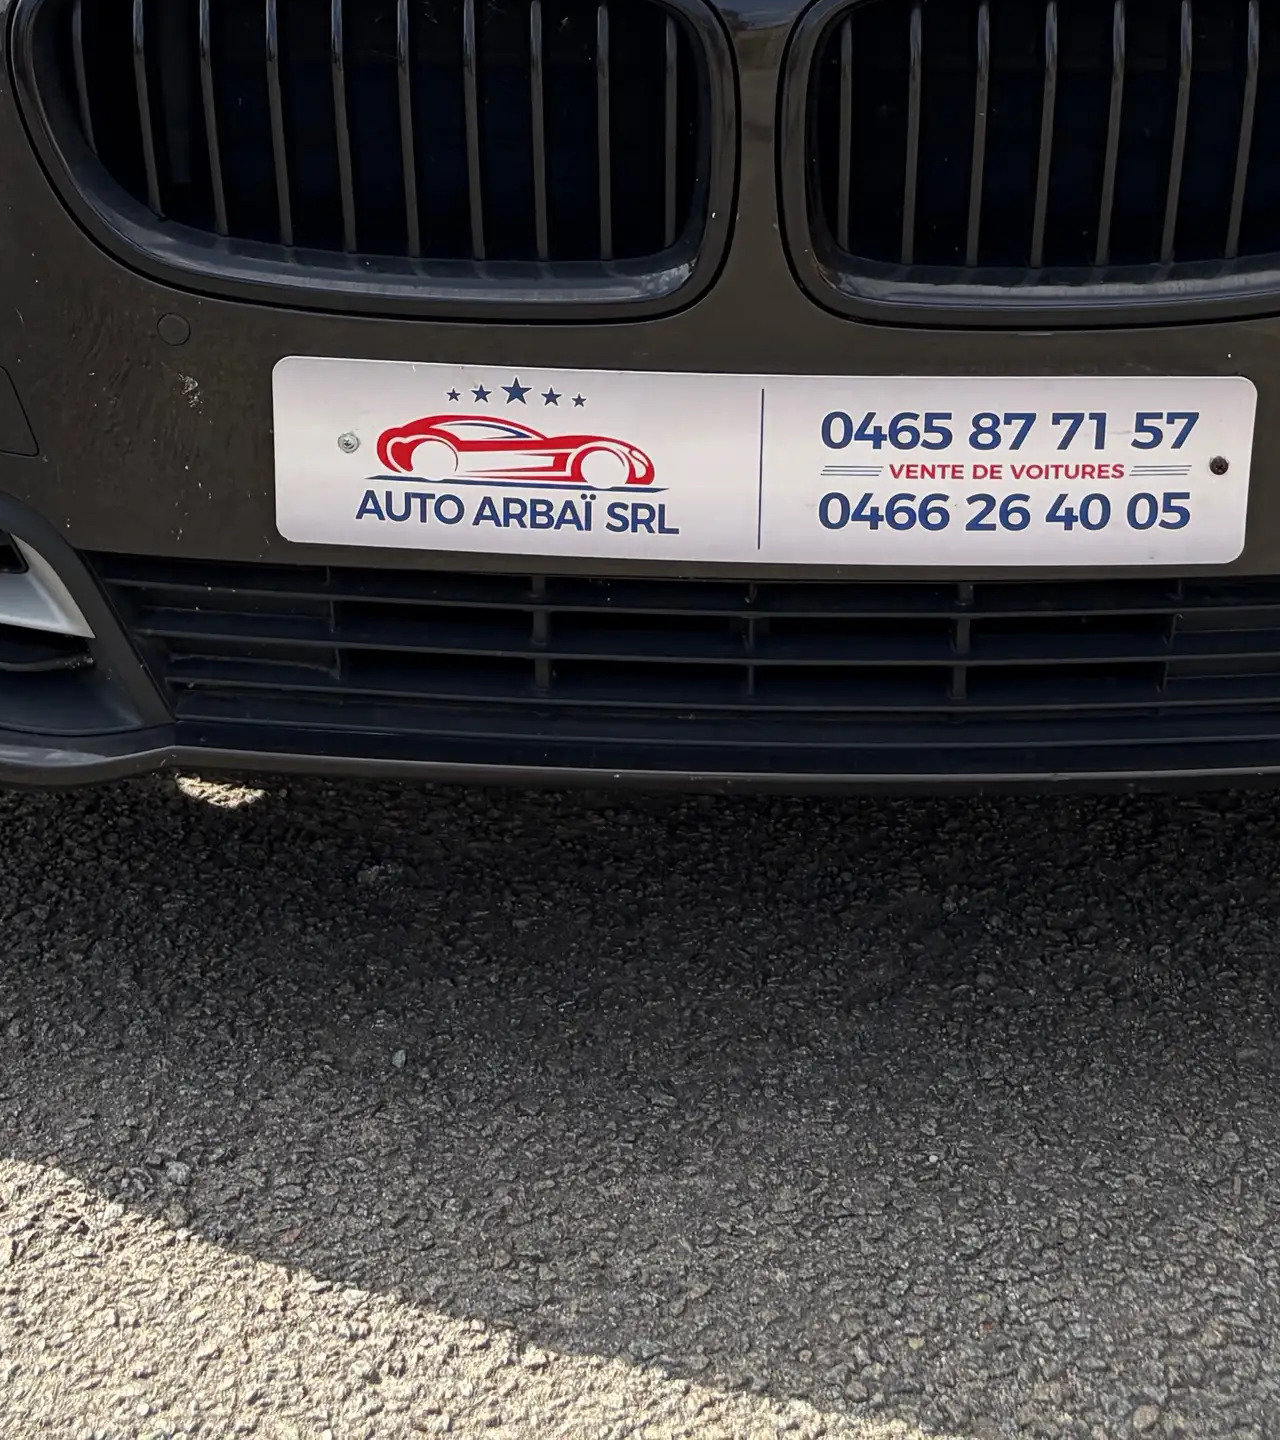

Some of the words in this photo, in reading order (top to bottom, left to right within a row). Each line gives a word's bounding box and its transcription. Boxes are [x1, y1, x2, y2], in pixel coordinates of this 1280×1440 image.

[820, 410, 954, 451] 0465
[967, 410, 1038, 451] 87
[1051, 411, 1108, 451] 71
[1130, 411, 1200, 451] 57
[888, 462, 965, 480] VENTE
[971, 463, 1003, 480] DE
[1009, 462, 1126, 481] VOITURES
[354, 489, 466, 524] AUTO
[472, 492, 598, 532] ARBAÏ
[605, 501, 680, 535] SRL
[818, 491, 951, 532] 0466
[964, 492, 1032, 532] 26
[1044, 492, 1113, 532] 40
[1125, 491, 1192, 531] 05
